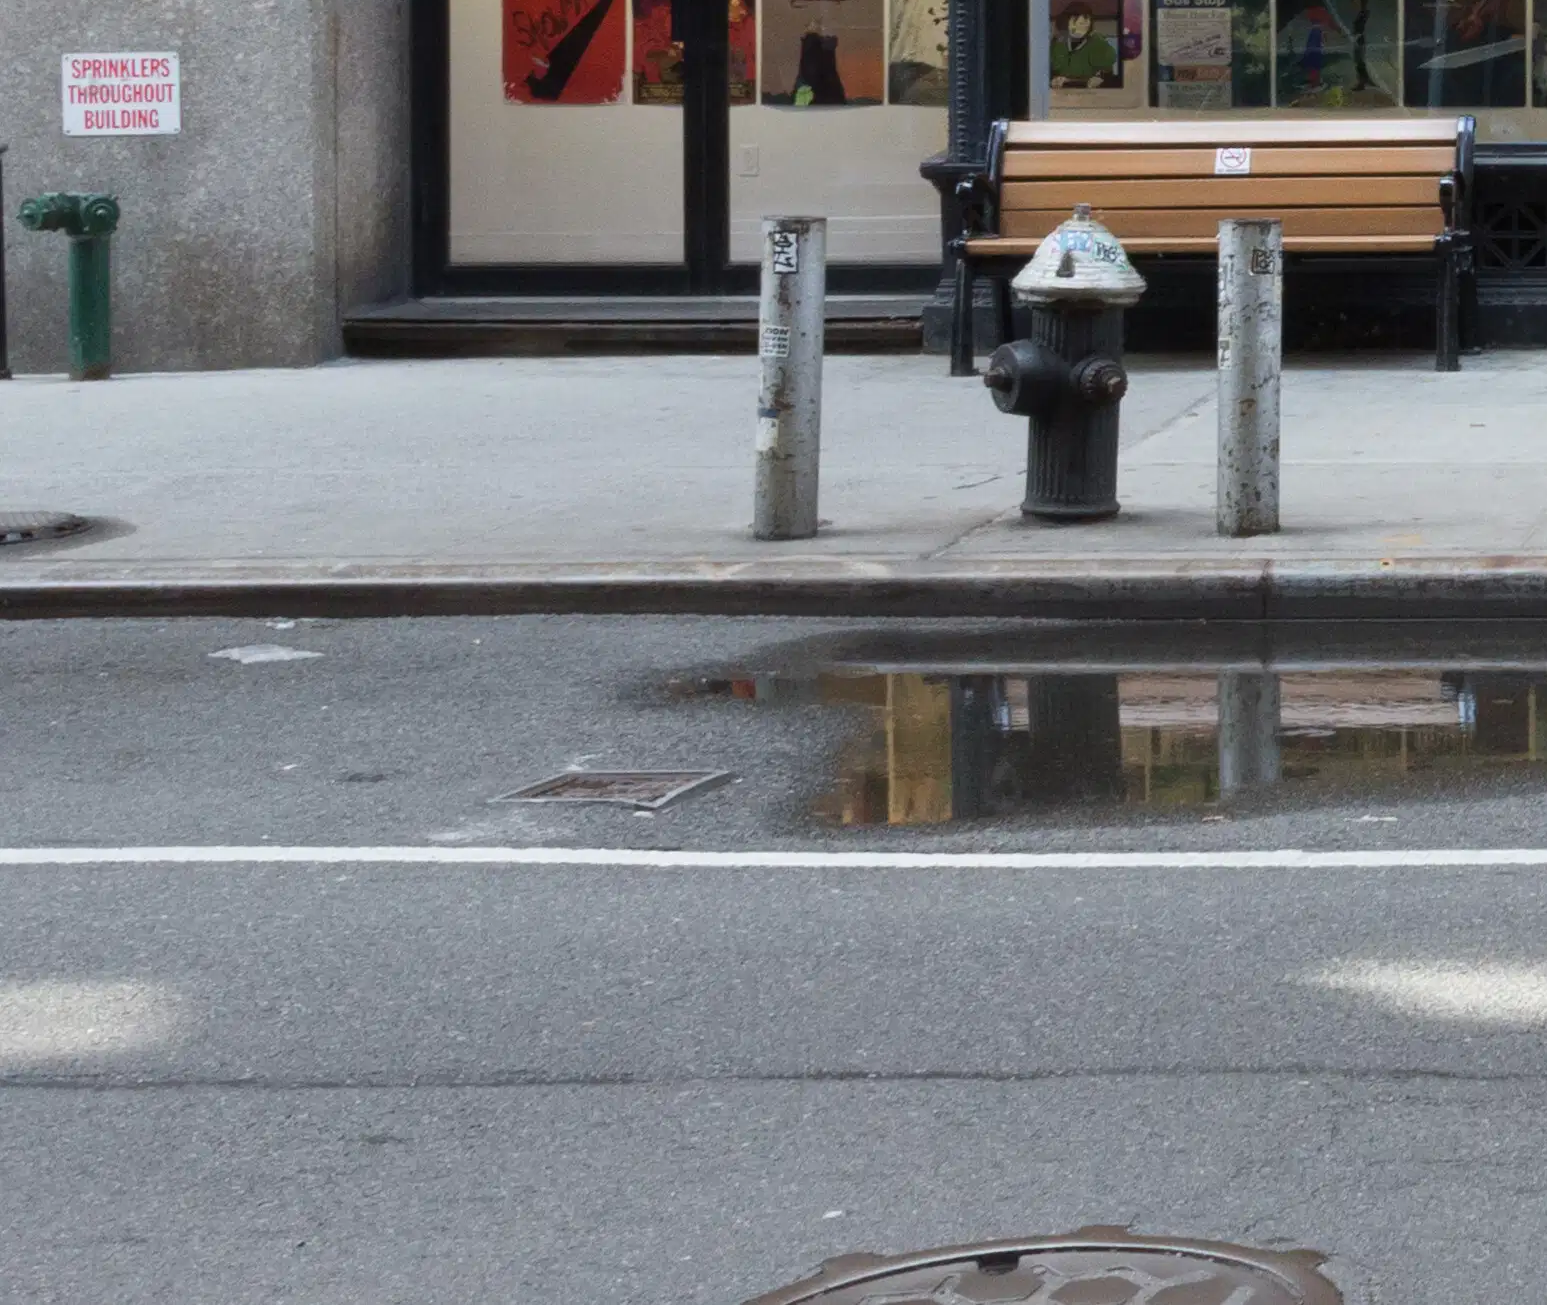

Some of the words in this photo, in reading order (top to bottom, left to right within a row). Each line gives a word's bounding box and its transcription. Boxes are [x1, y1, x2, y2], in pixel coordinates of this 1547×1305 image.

[71, 57, 170, 79] SPRINKLERS
[67, 82, 176, 105] THROUGHOUT
[84, 109, 160, 130] BUILDING
